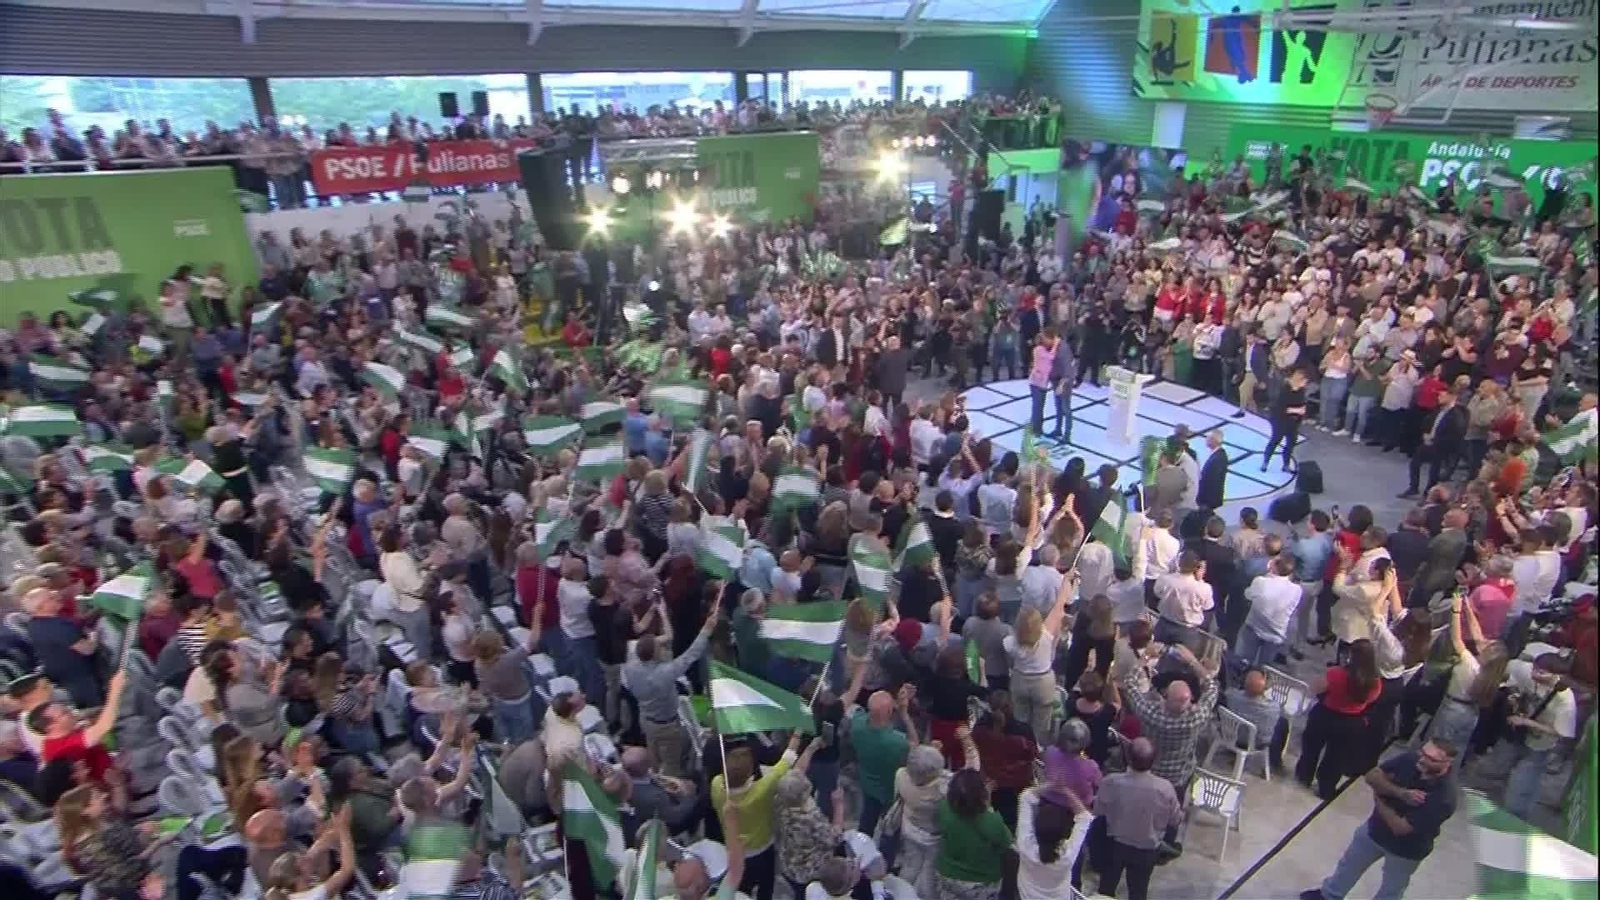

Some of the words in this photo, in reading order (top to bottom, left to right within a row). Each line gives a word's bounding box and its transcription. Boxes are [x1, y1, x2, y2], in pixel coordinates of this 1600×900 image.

[1464, 76, 1490, 89] DE
[1491, 75, 1580, 89] DEPORTES
[324, 155, 387, 180] PSOE
[393, 153, 405, 177] /
[1419, 158, 1488, 191] PSO
[0, 196, 114, 252] OTA
